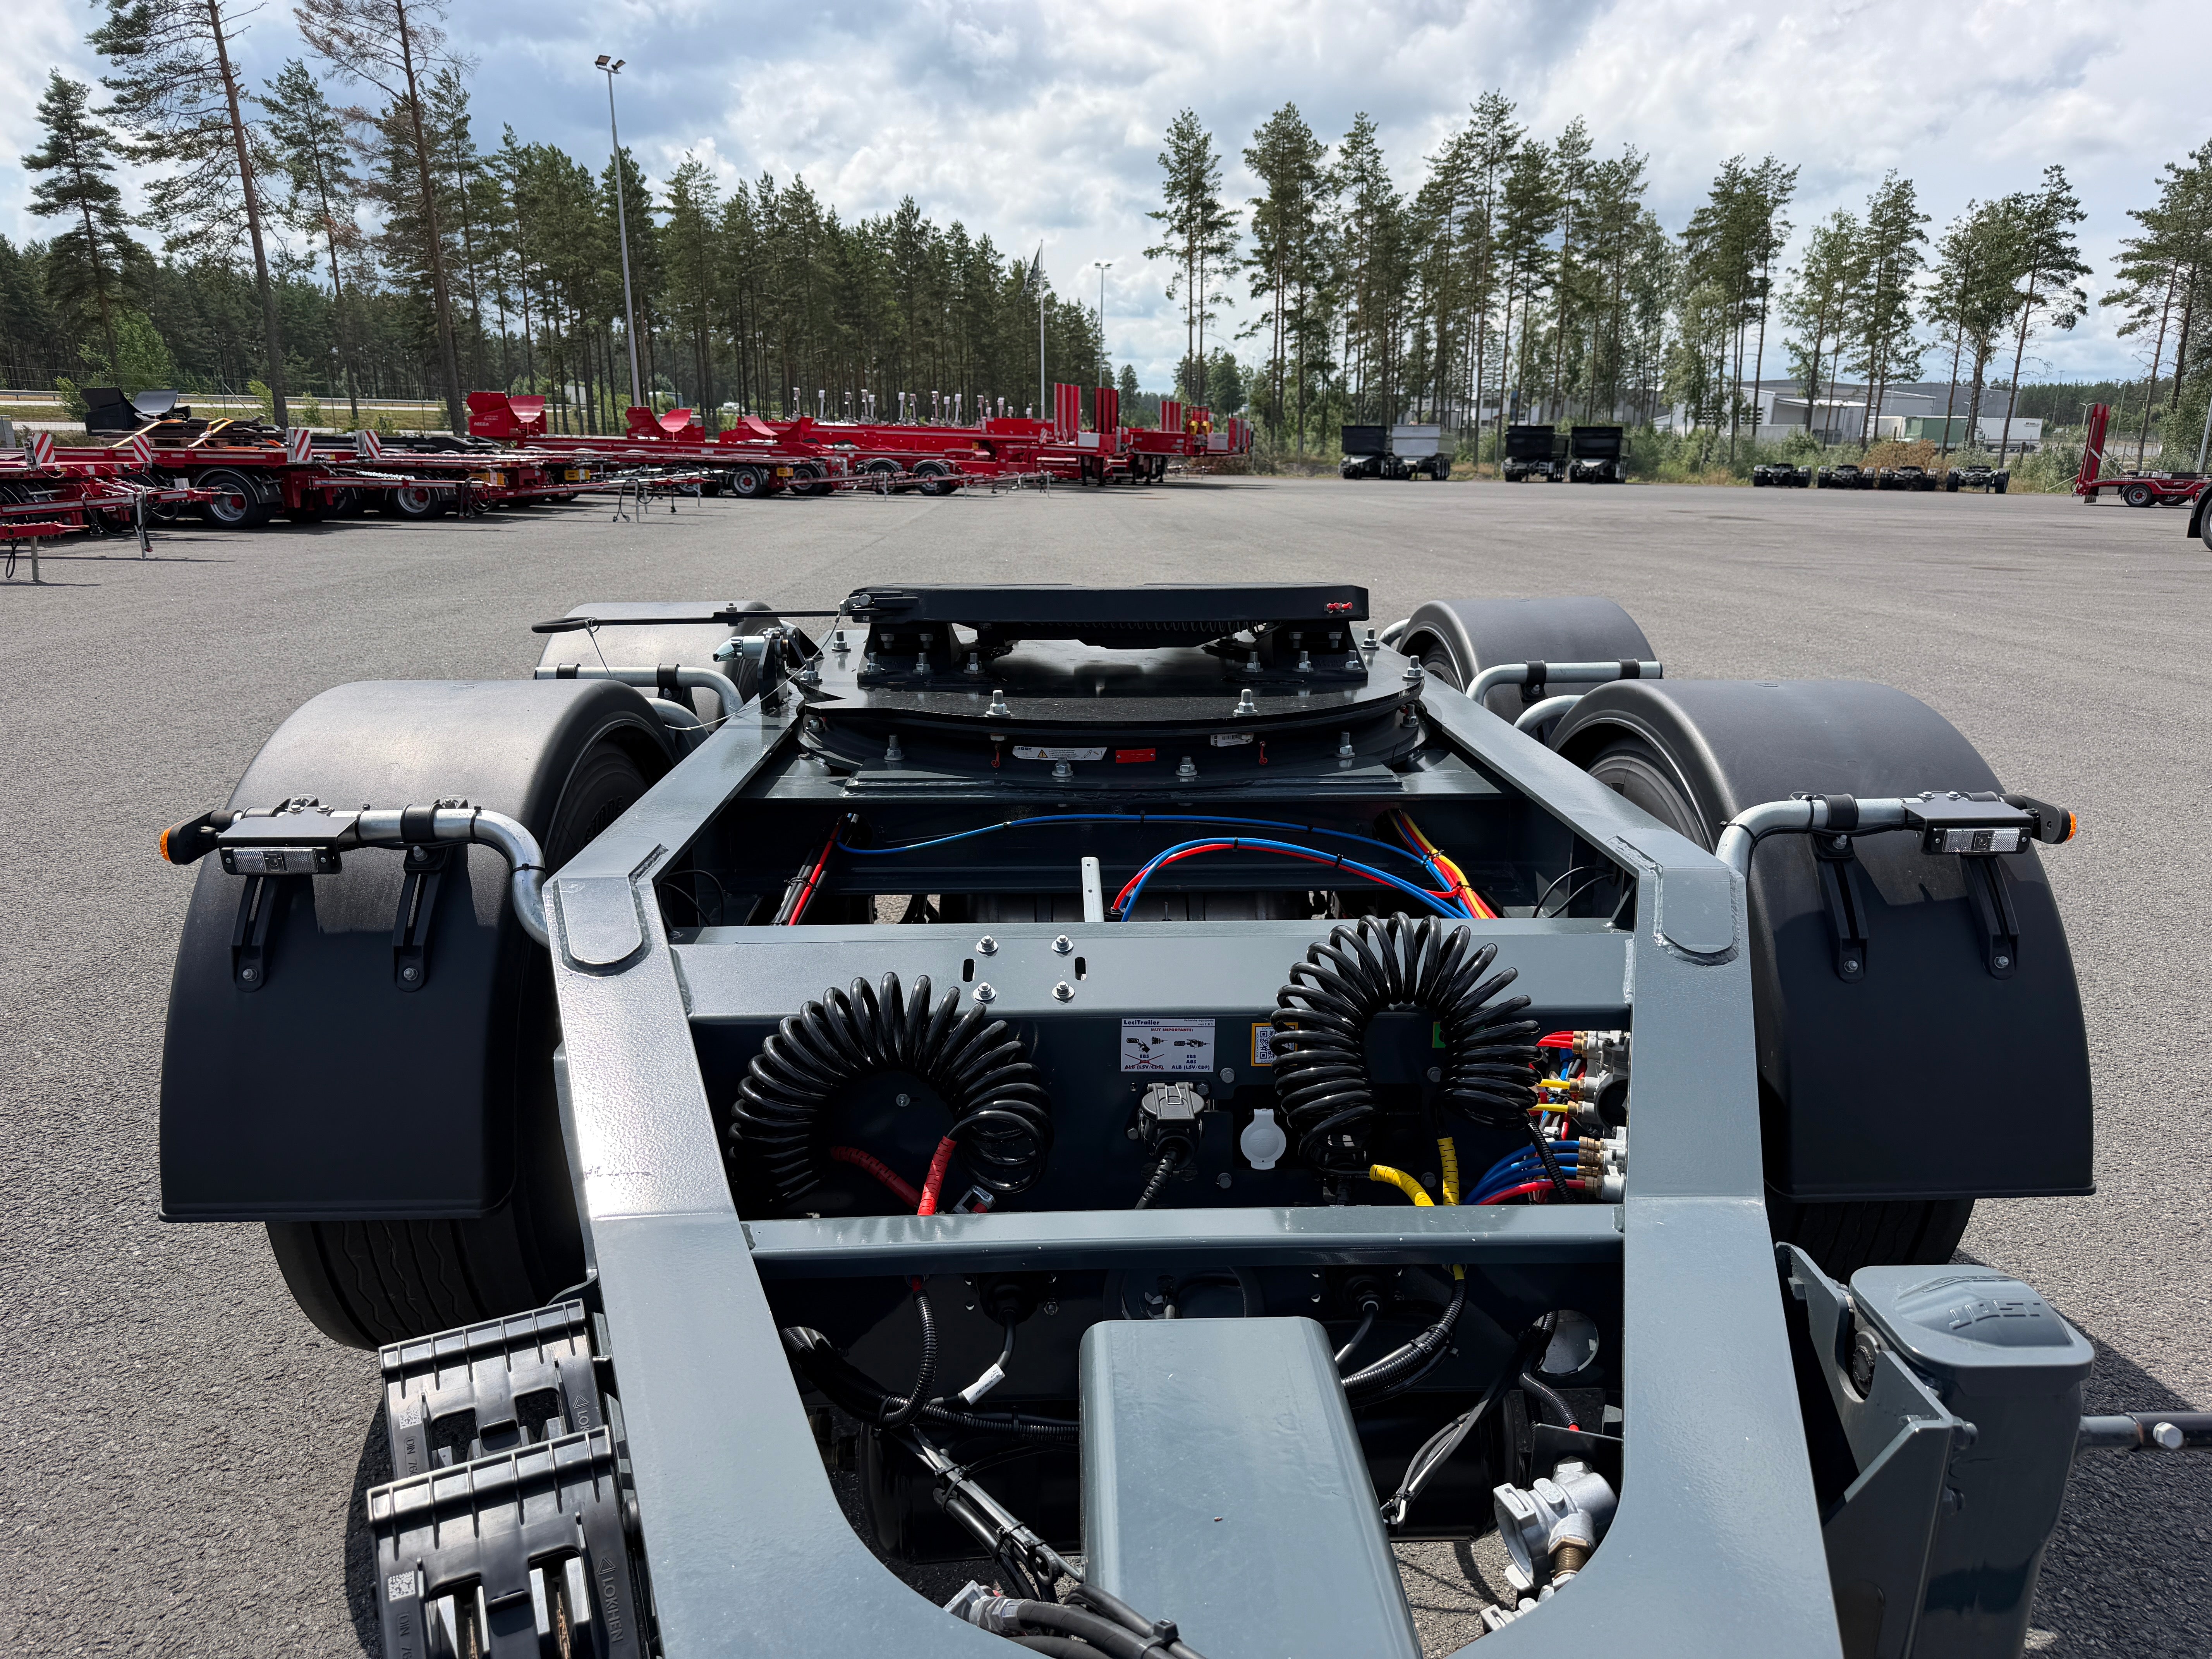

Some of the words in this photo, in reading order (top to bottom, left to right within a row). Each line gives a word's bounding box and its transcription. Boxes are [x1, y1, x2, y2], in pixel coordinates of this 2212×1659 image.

[1949, 1300, 2041, 1329] JOST
[577, 1410, 591, 1431] LOK
[406, 1439, 416, 1455] DIN
[602, 1577, 623, 1643] LOKHEN
[399, 1613, 410, 1637] DIN
